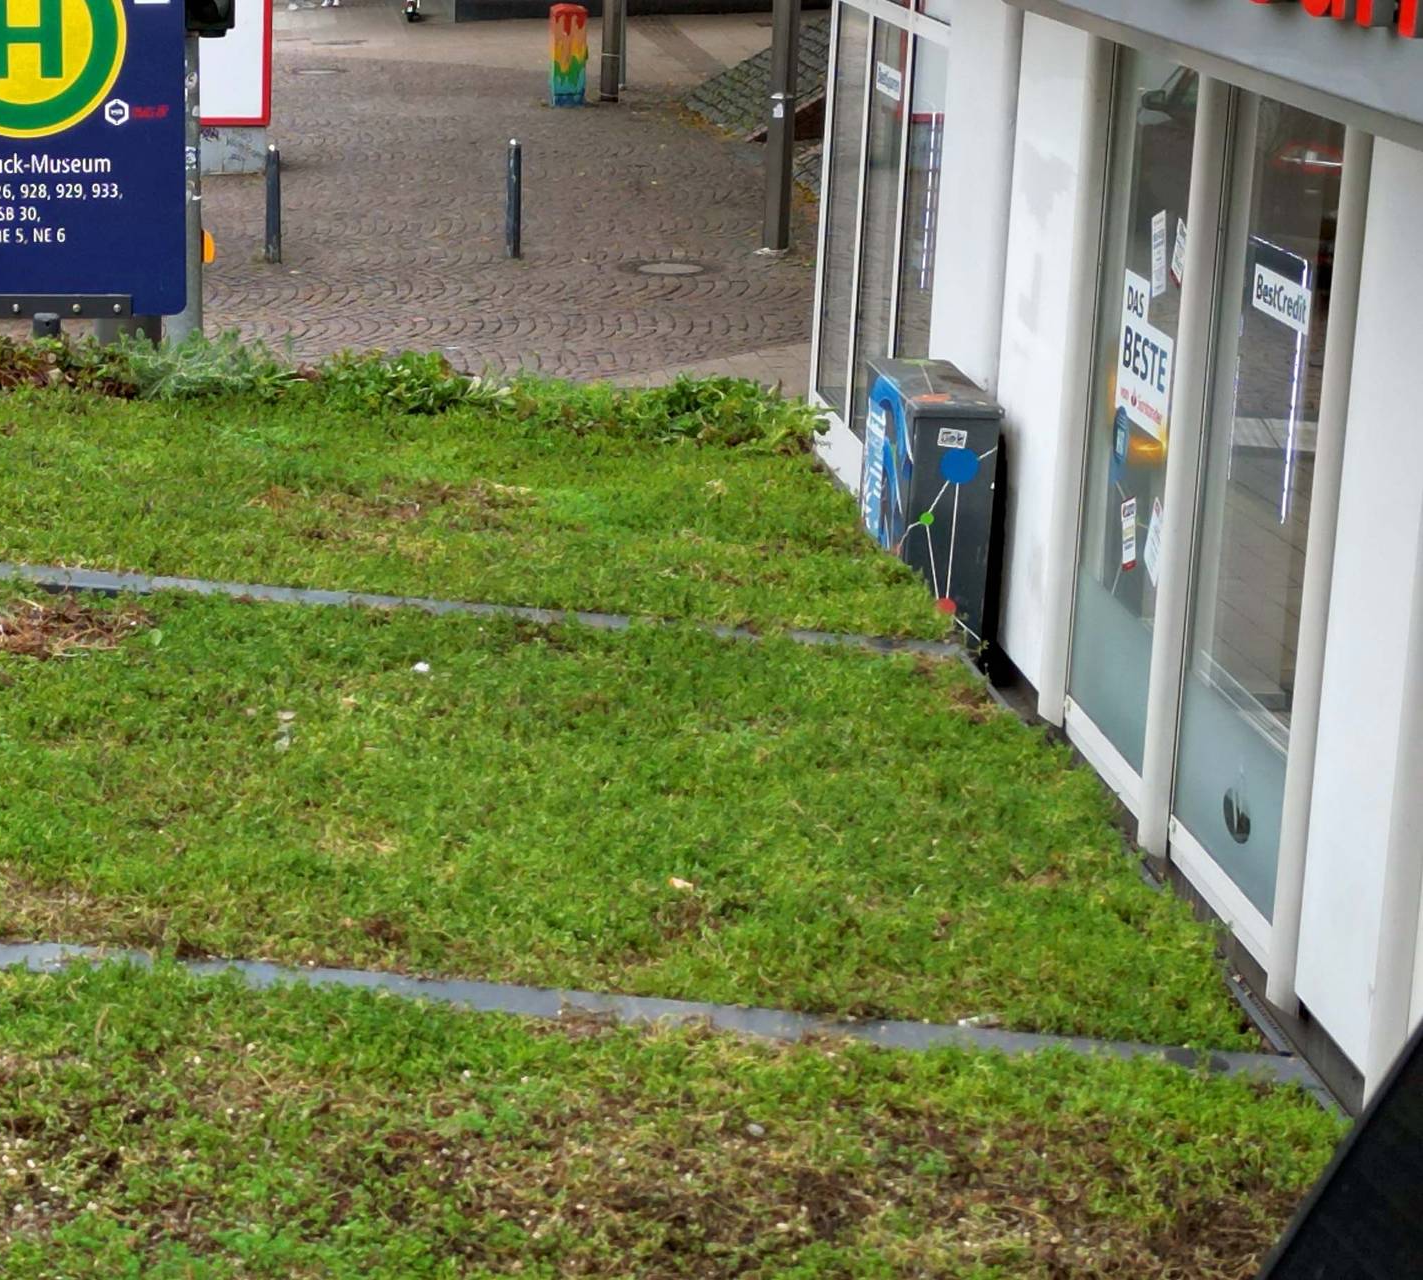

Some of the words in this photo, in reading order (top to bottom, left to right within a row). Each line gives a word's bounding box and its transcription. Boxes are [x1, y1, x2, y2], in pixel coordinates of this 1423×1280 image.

[20, 184, 51, 200] 928,
[56, 183, 87, 200] 929,
[91, 183, 123, 200] 933,
[19, 206, 41, 222] 30,
[15, 228, 28, 244] 5,
[33, 228, 52, 242] NE
[56, 228, 66, 242] 6
[1127, 285, 1144, 318] DAS
[1256, 272, 1307, 324] BestCredit
[1123, 325, 1167, 394] BESTE
